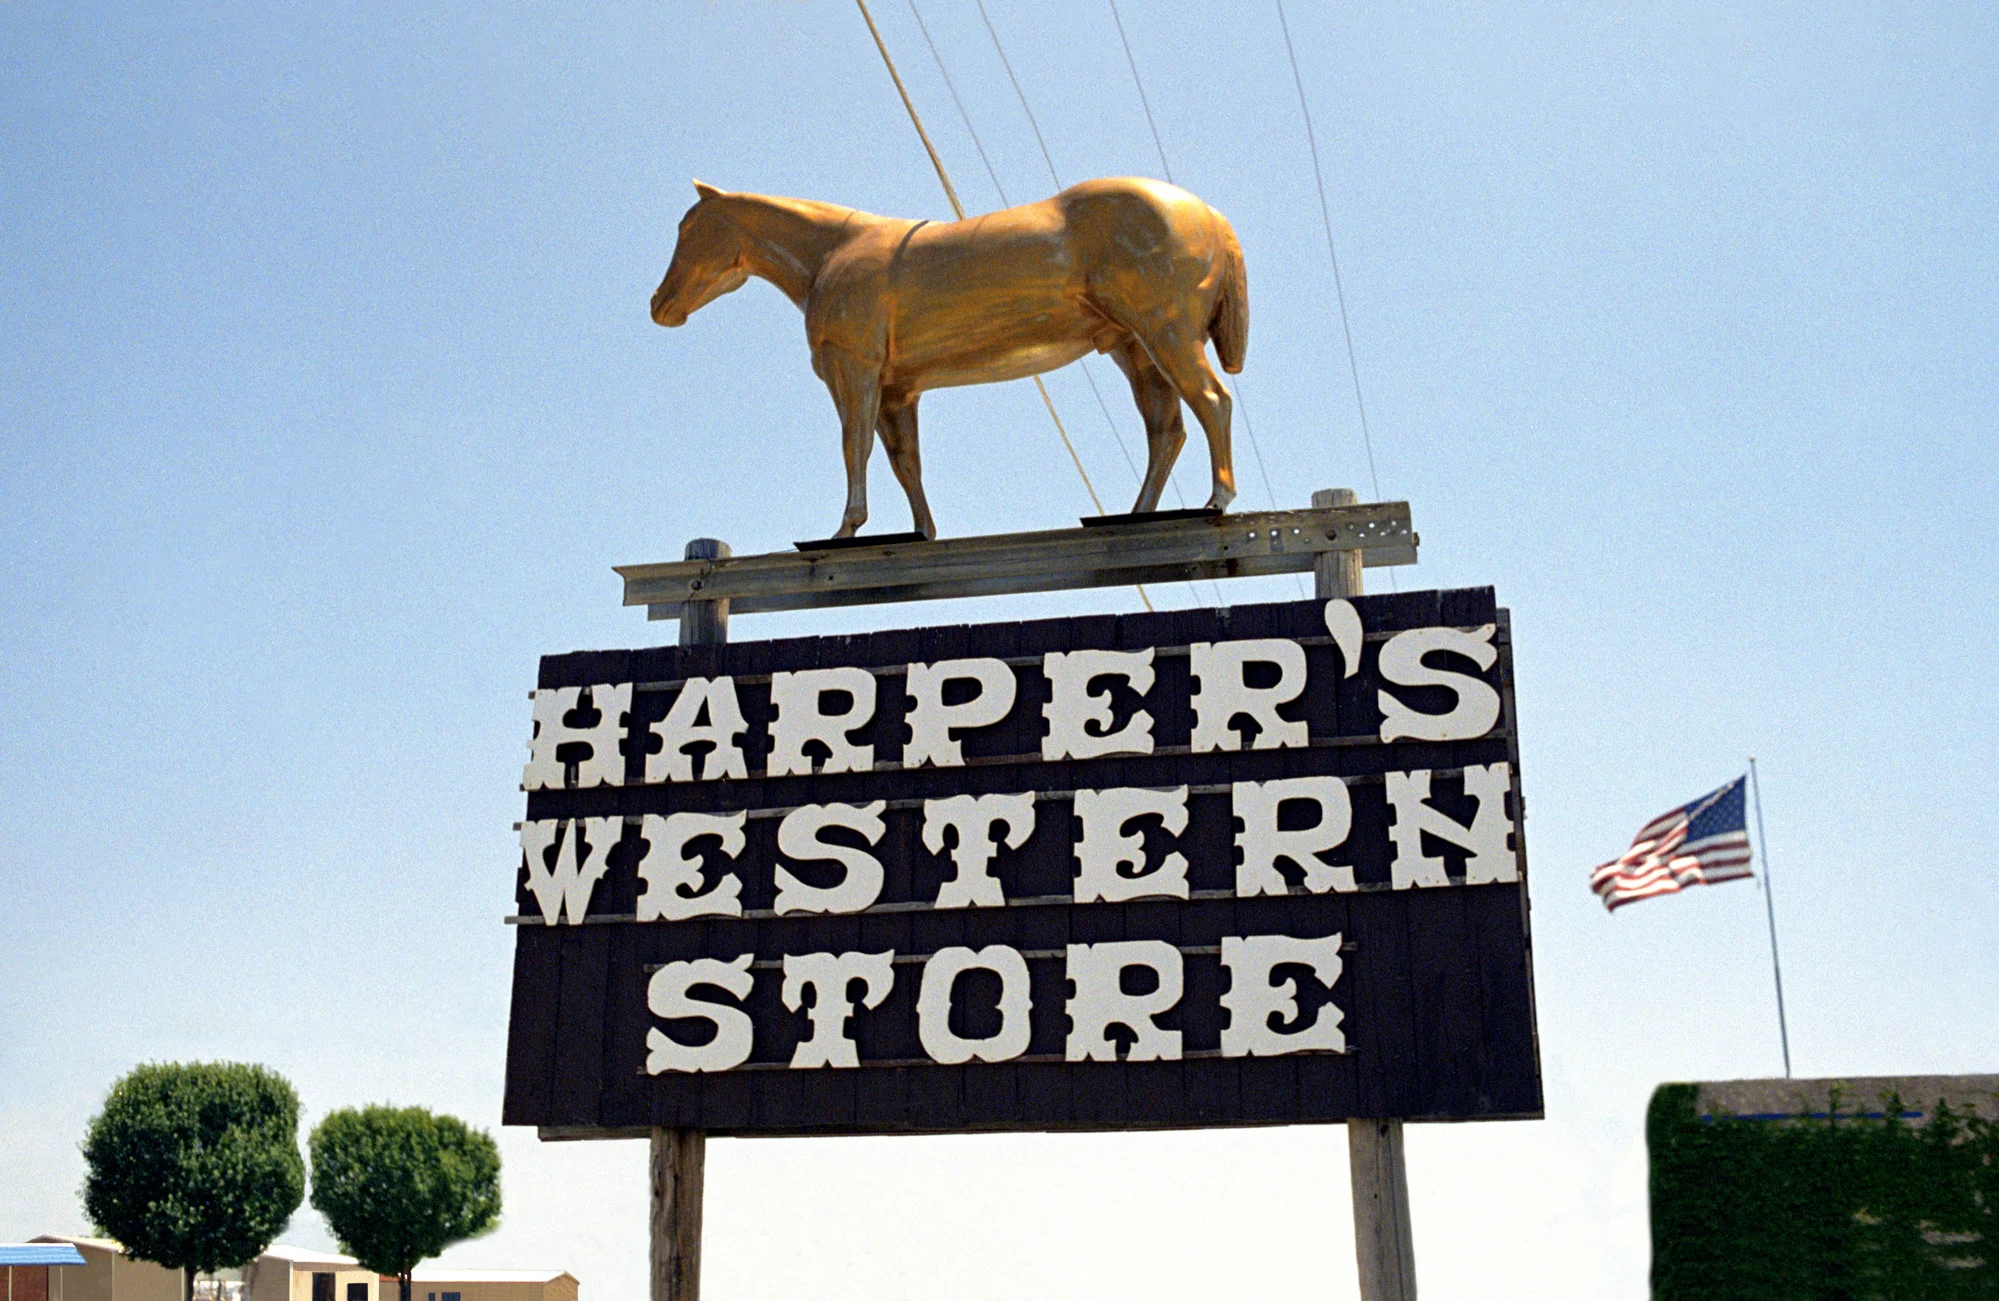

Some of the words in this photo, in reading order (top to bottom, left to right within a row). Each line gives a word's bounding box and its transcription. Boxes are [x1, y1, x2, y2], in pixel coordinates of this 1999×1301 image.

[522, 598, 1500, 791] HARPER'S
[519, 761, 1520, 926] WESTERN
[645, 931, 1346, 1076] STORE
